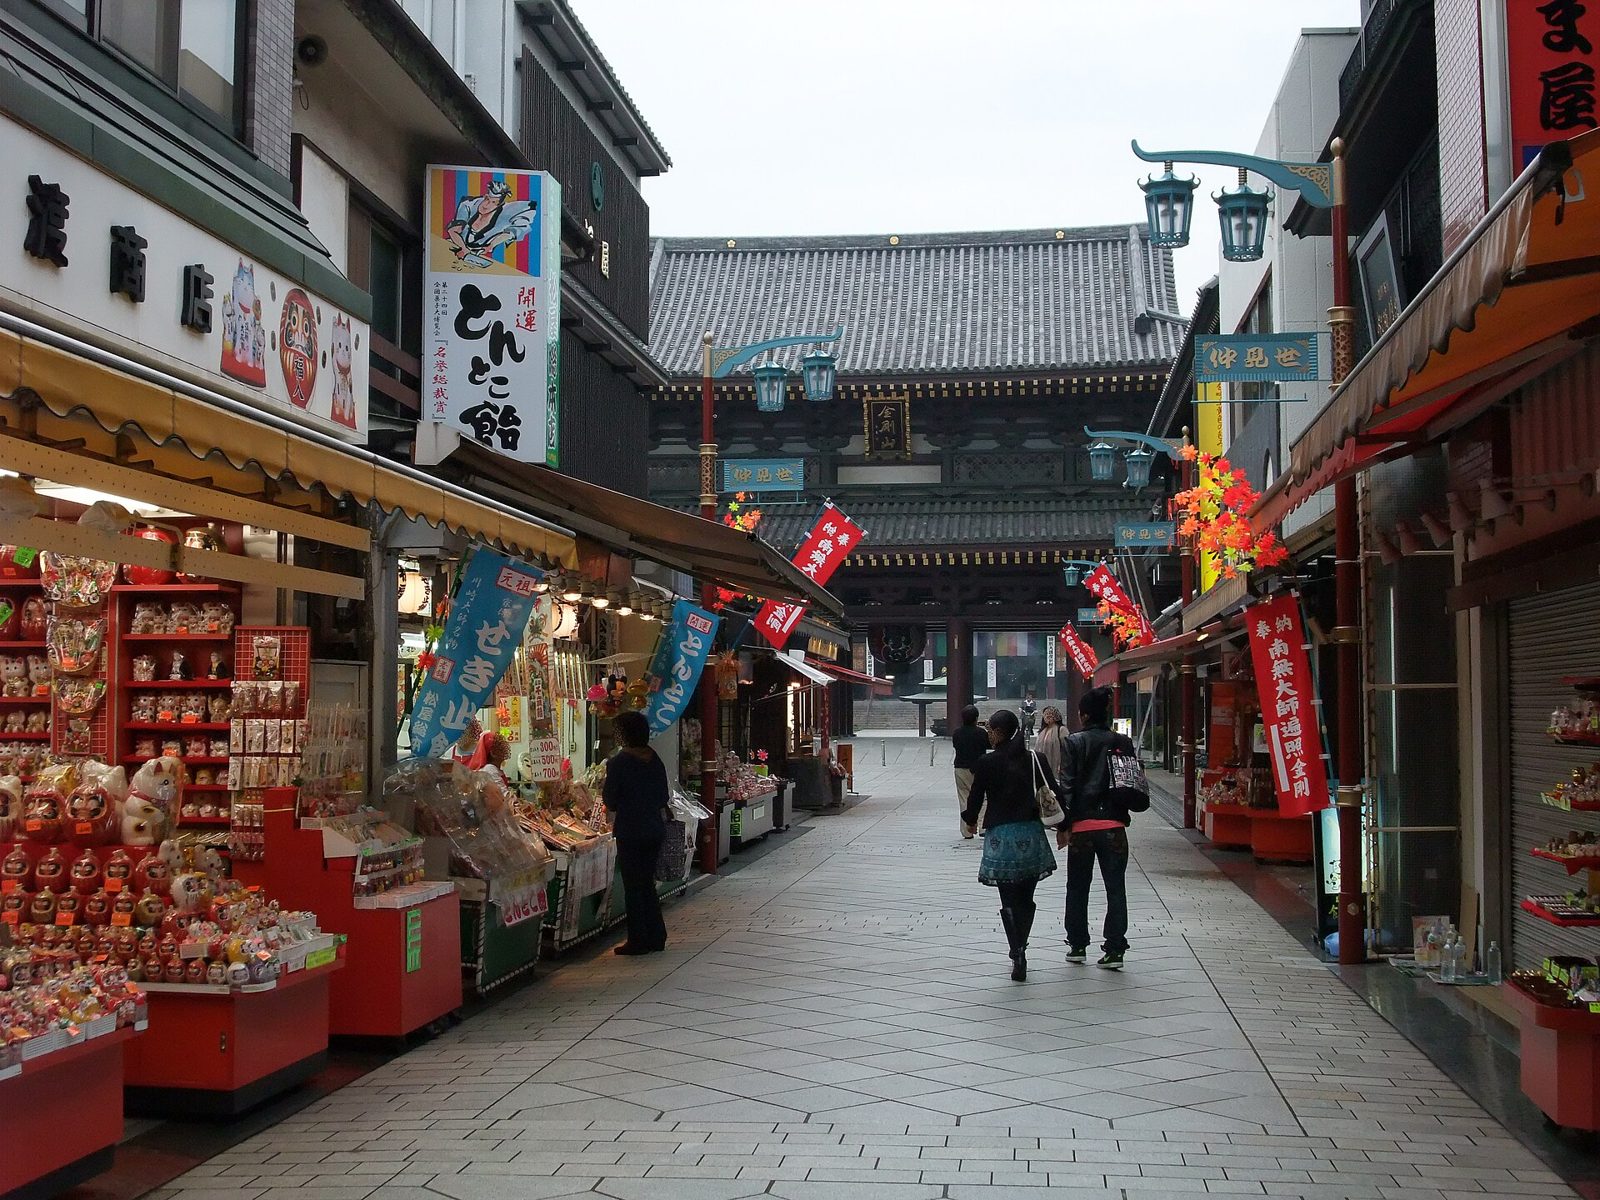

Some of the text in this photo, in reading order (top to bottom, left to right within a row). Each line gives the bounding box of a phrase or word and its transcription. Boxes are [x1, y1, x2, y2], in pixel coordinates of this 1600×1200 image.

[516, 286, 537, 332] 開運
[454, 284, 526, 451] とんとこ飴
[1210, 346, 1302, 369] 仲見世
[877, 405, 896, 449] 金剛山
[733, 467, 794, 482] 仲見世
[1122, 528, 1167, 540] 仲見世
[500, 572, 532, 594] 元祖
[1255, 614, 1293, 640] 奉納
[1268, 638, 1312, 798] 南無大師遍照金剛
